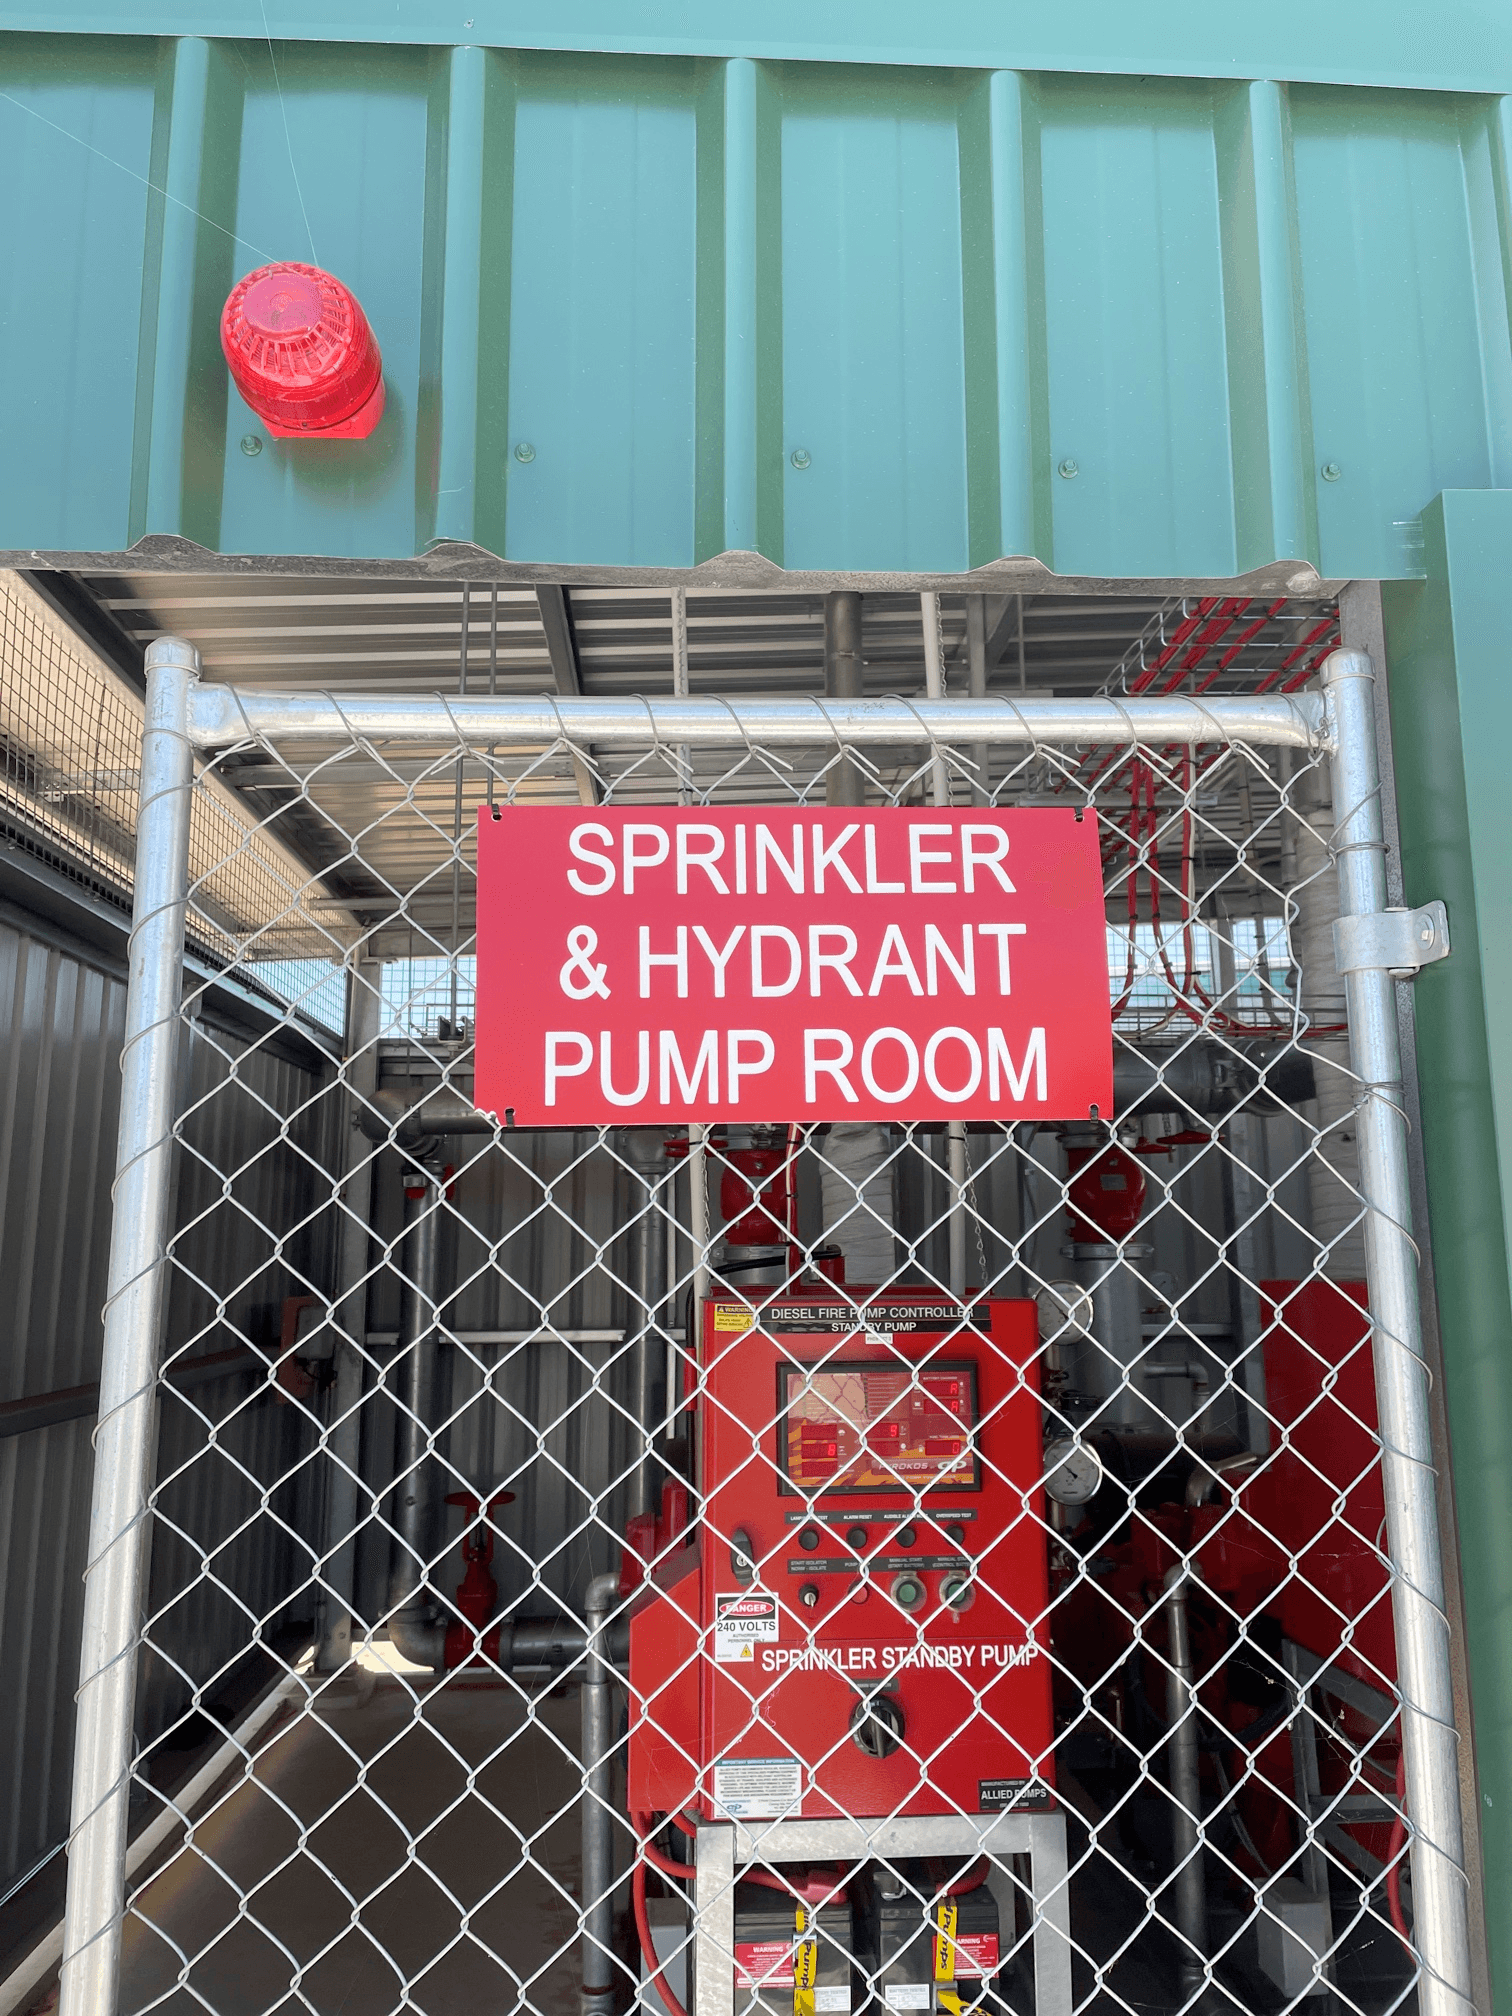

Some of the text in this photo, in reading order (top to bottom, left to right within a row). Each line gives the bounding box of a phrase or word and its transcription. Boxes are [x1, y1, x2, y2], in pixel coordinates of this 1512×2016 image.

[566, 822, 1017, 896] SPRINKLER
[559, 922, 1027, 1000] & HYDRANT
[544, 1026, 1048, 1106] PUMP ROOM
[771, 1307, 815, 1319] DIESEL
[818, 1307, 846, 1319] FIRE
[884, 1322, 917, 1331] PUMP
[717, 1621, 776, 1632] 240 VOLTS
[761, 1644, 1039, 1672] SPRINKLER STANDBY PUMP
[981, 1789, 1013, 1800] ALLIED
